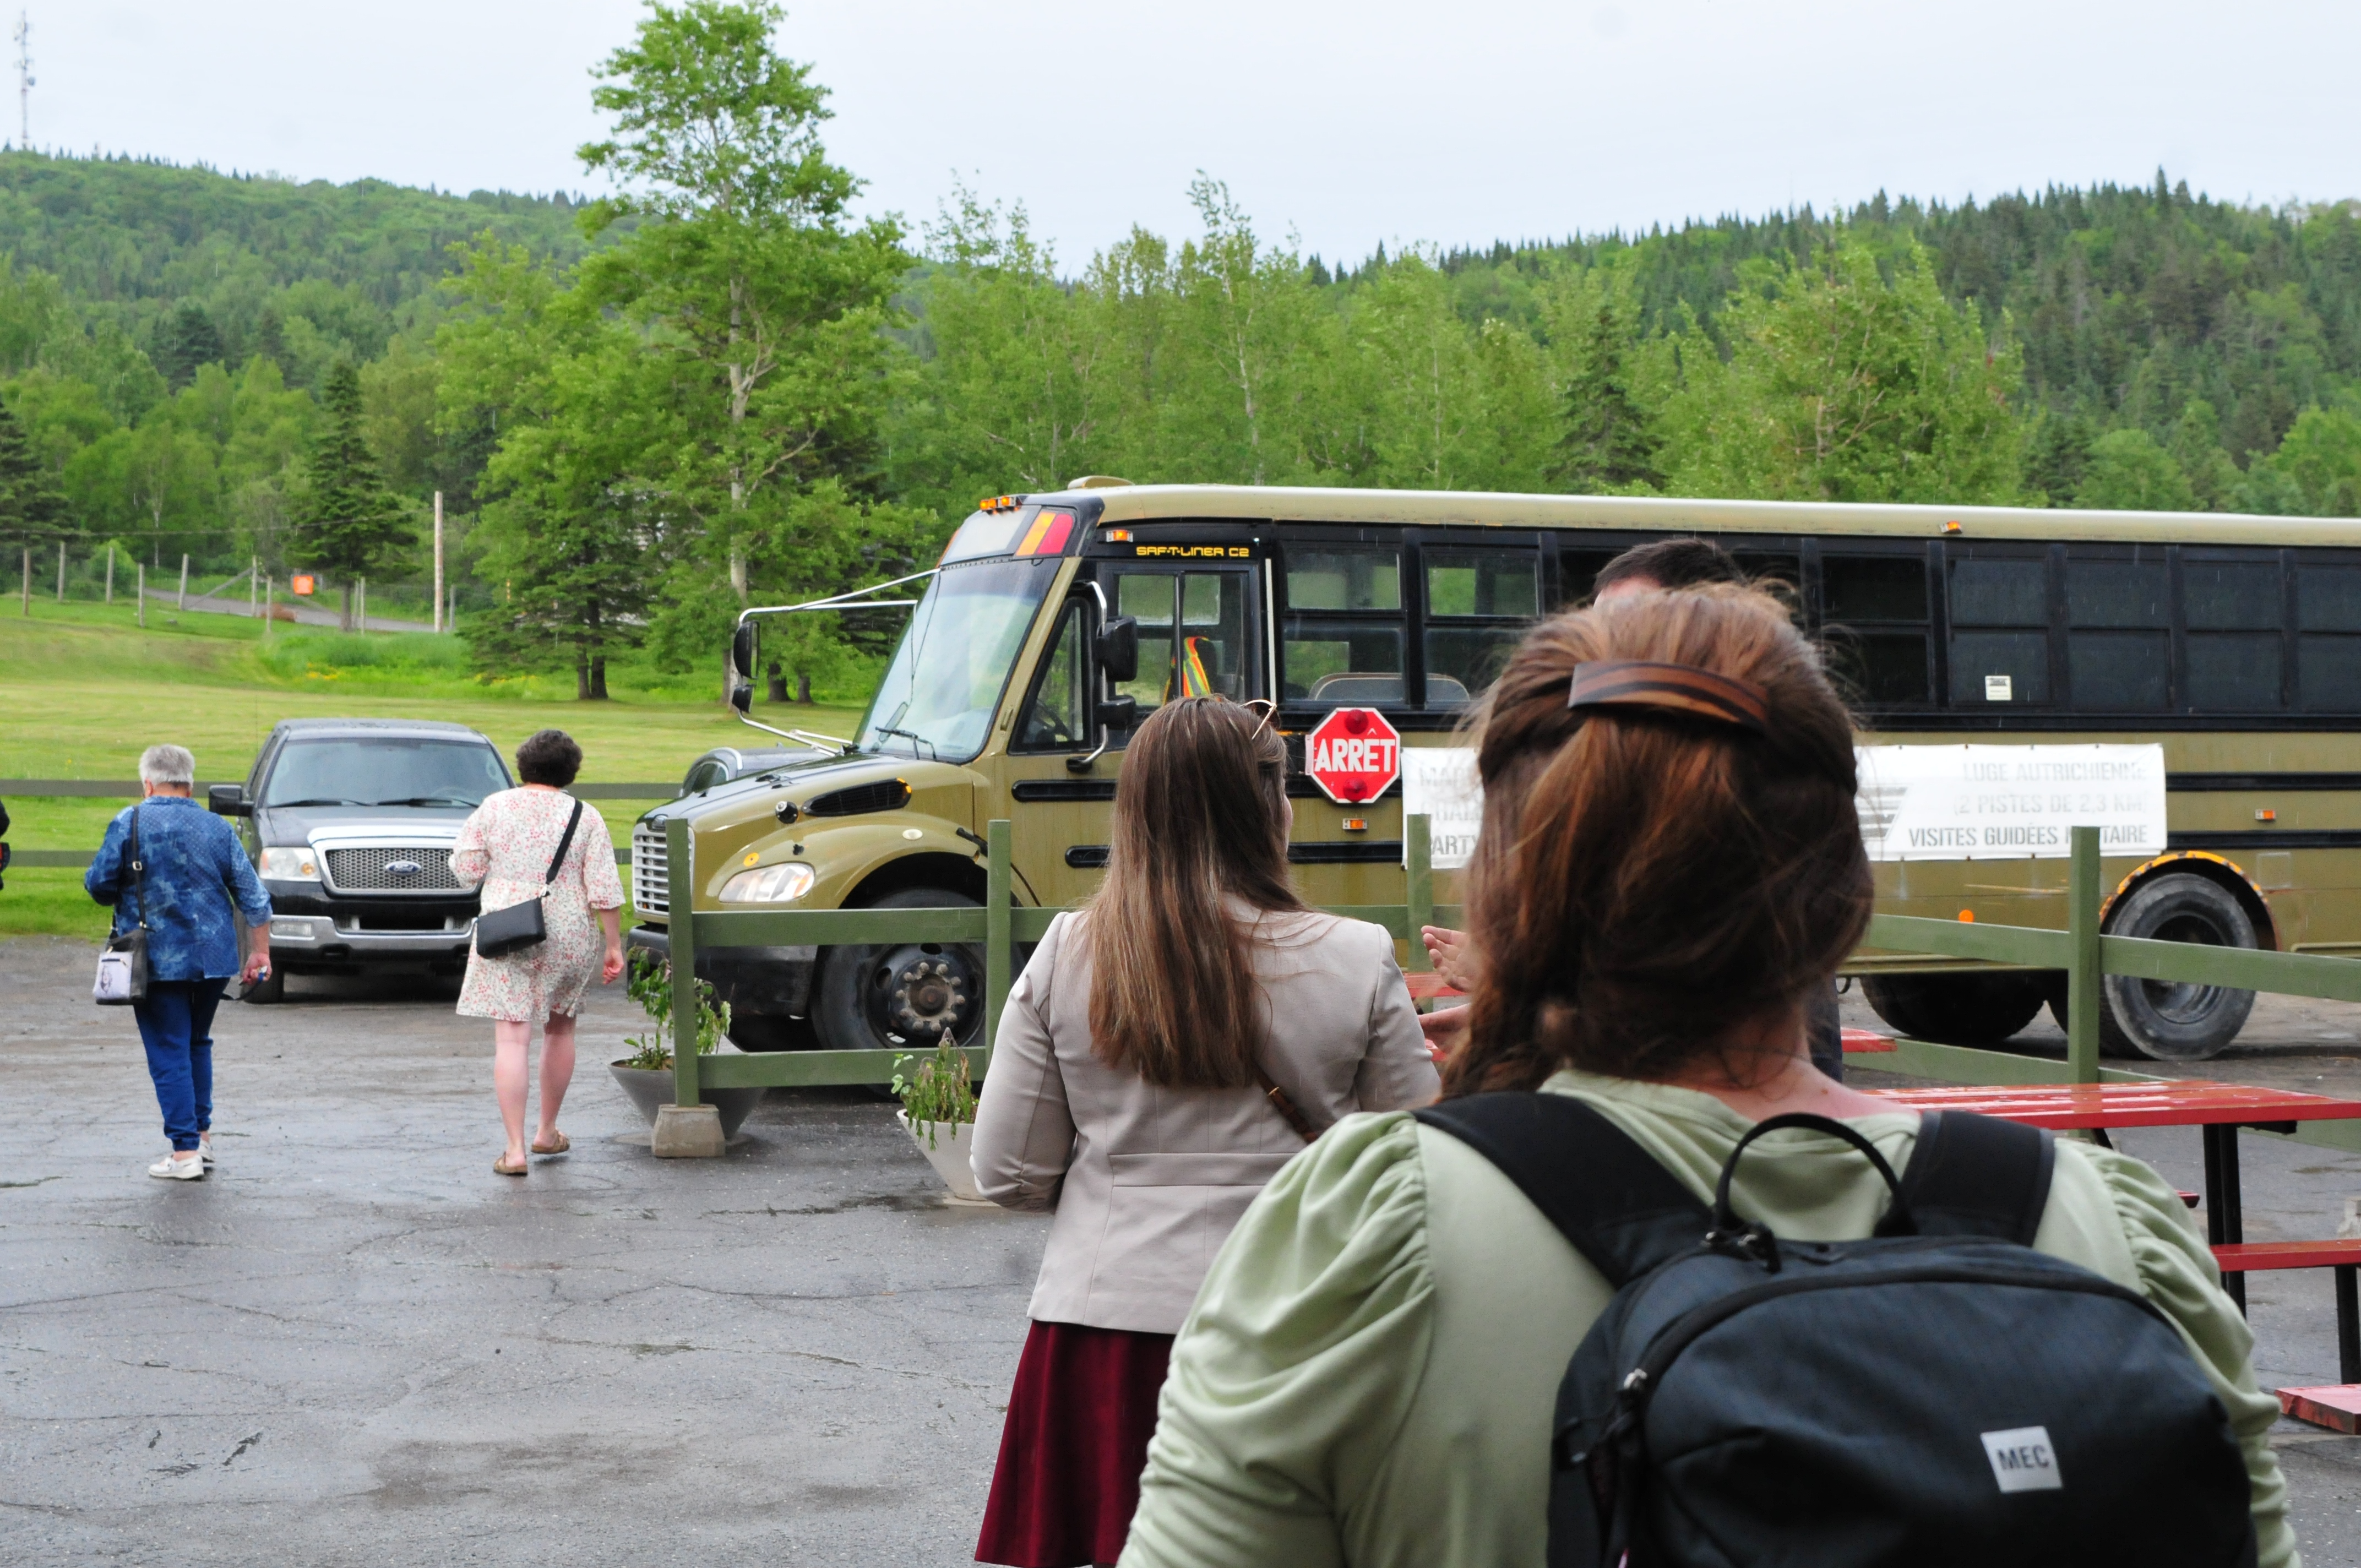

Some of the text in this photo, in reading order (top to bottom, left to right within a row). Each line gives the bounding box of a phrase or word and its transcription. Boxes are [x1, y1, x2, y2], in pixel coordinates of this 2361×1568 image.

[1228, 547, 1250, 557] C2
[1314, 727, 1396, 772] ARRÊT
[1963, 762, 2009, 782] LUGE
[1978, 793, 2043, 814] PISTES
[2050, 793, 2072, 813] DE
[2079, 793, 2107, 815] 2,3
[1908, 827, 1977, 848] VISITES
[1984, 823, 2058, 846] GUIDÉES
[1997, 1445, 2049, 1470] MEC
